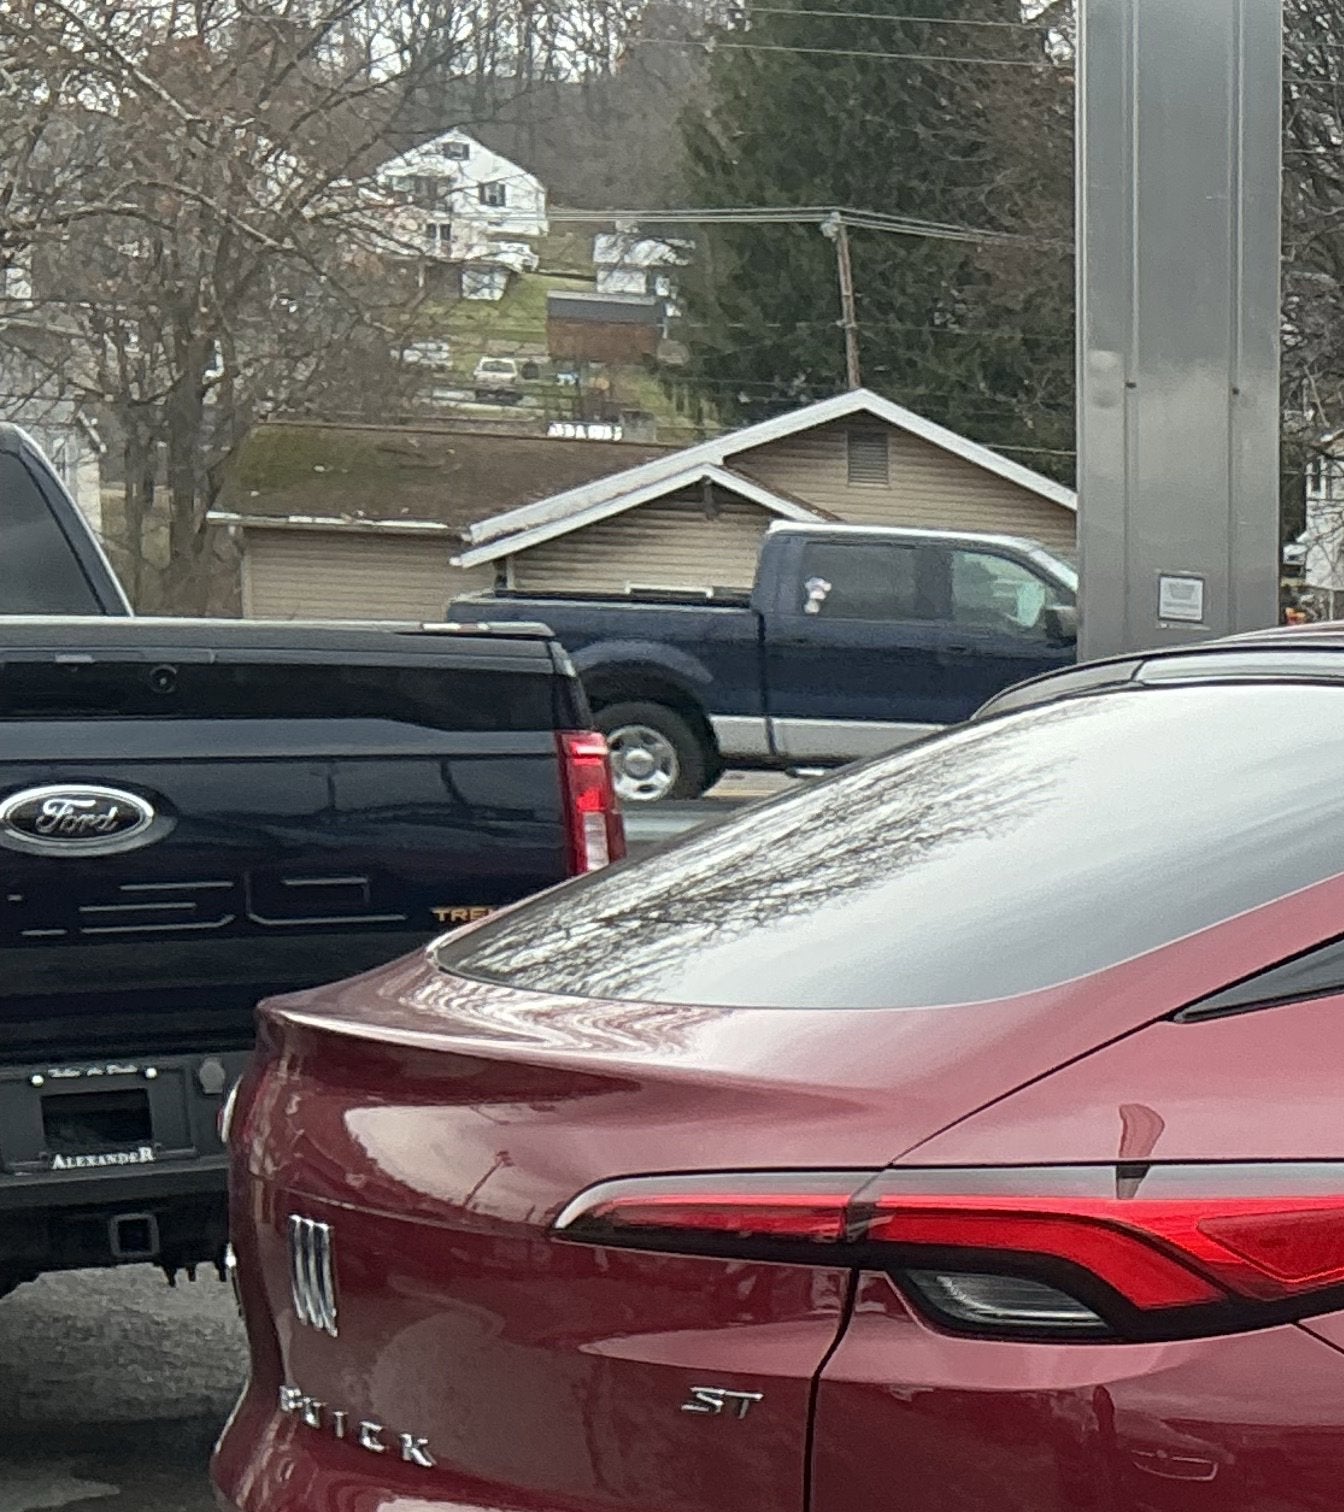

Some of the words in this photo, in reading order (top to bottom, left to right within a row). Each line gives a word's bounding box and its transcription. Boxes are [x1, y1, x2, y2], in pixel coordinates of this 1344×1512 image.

[35, 799, 119, 833] Ford
[431, 907, 497, 922] TRE
[51, 1146, 156, 1170] ALEXANDER
[681, 1386, 764, 1420] ST
[279, 1385, 437, 1468] BUICK
